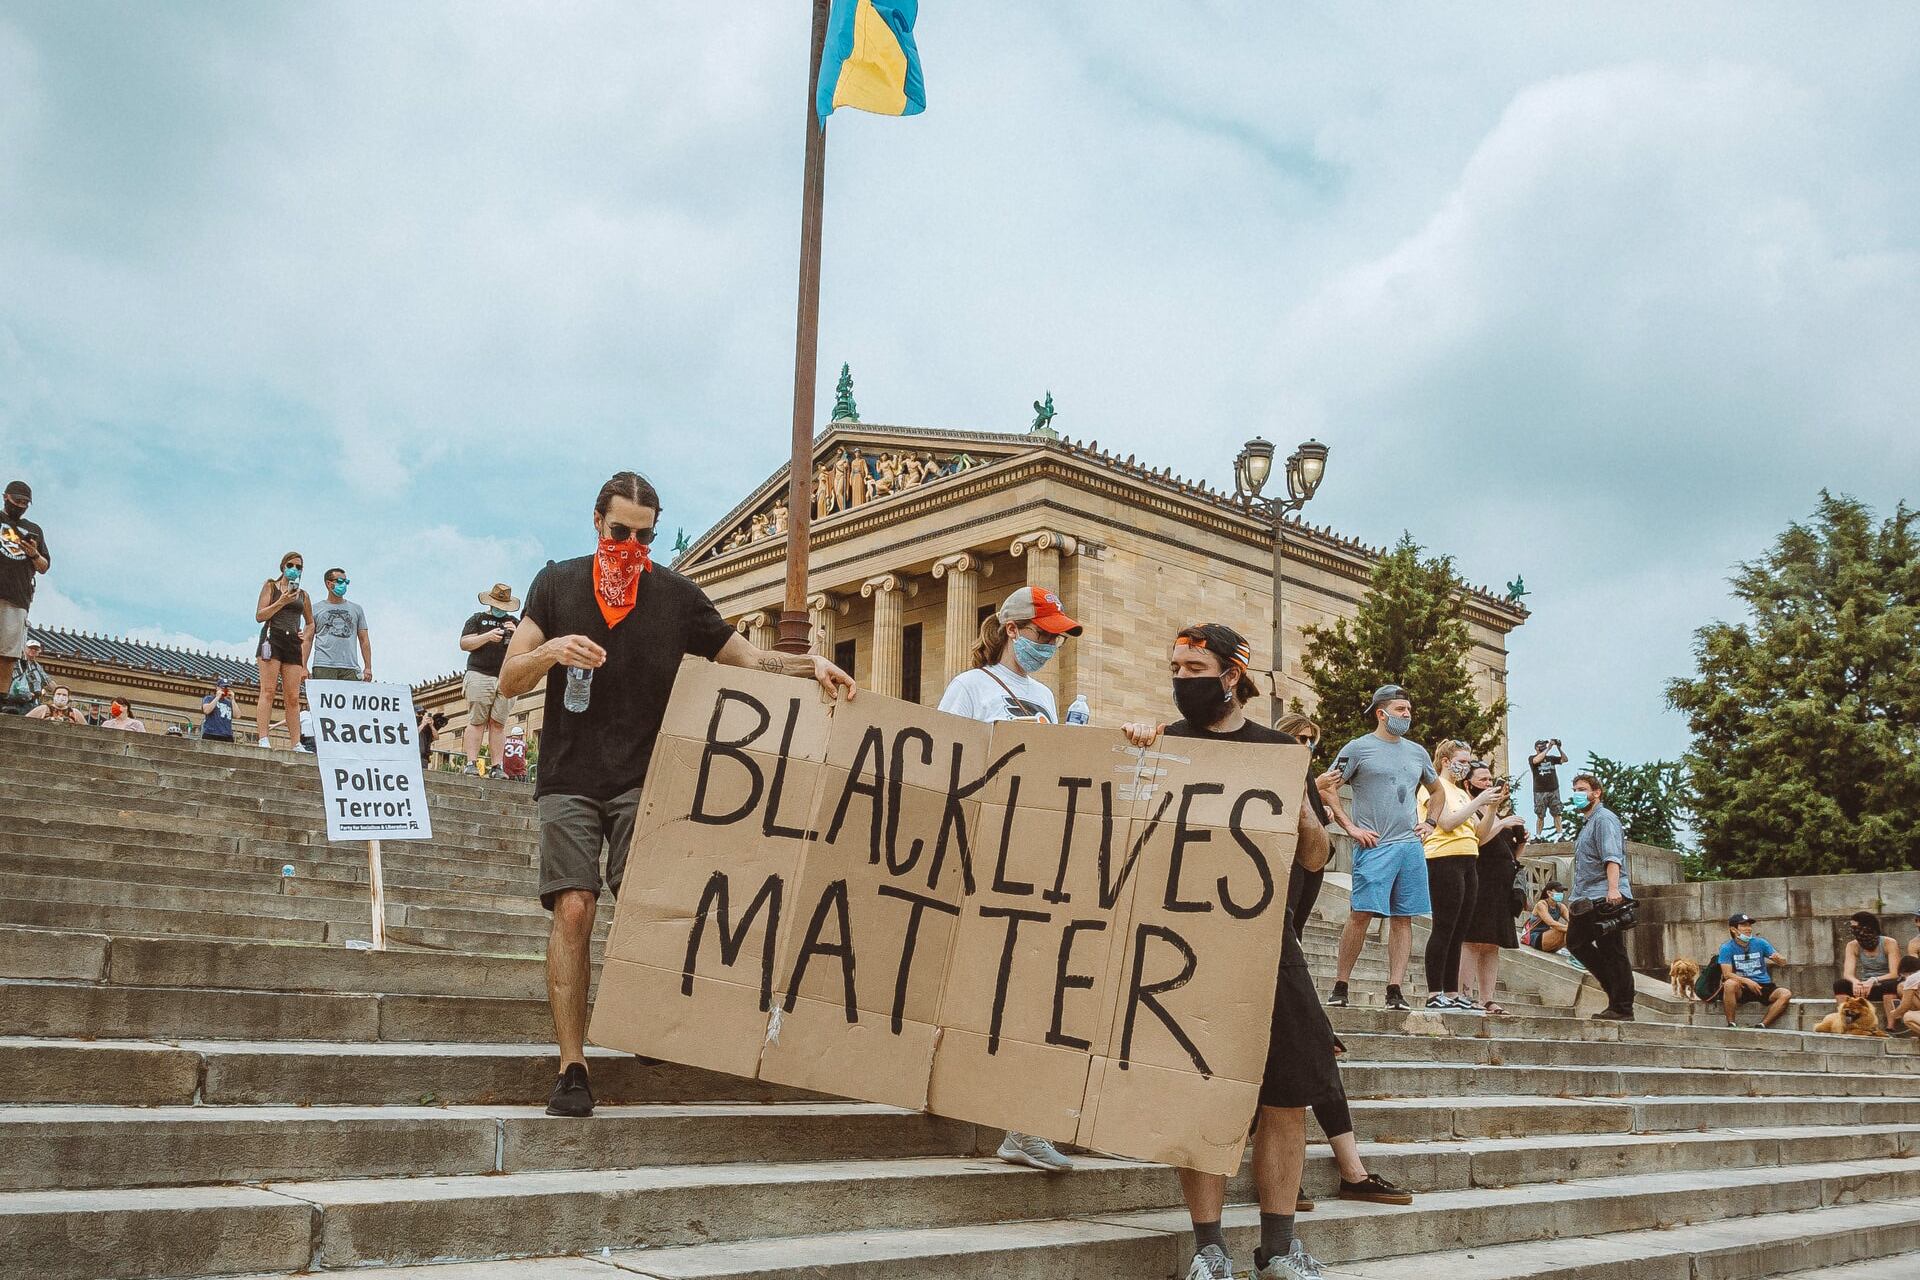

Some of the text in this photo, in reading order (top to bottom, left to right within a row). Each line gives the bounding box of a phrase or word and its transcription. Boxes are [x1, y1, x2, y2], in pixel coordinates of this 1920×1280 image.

[320, 693, 400, 711] NO MORE
[319, 717, 410, 745] Racist
[504, 744, 524, 758] 34
[334, 768, 409, 791] Police
[335, 798, 412, 817] Terror!
[689, 687, 1284, 920] BLACK LIVES
[681, 869, 1215, 1081] MATTER
